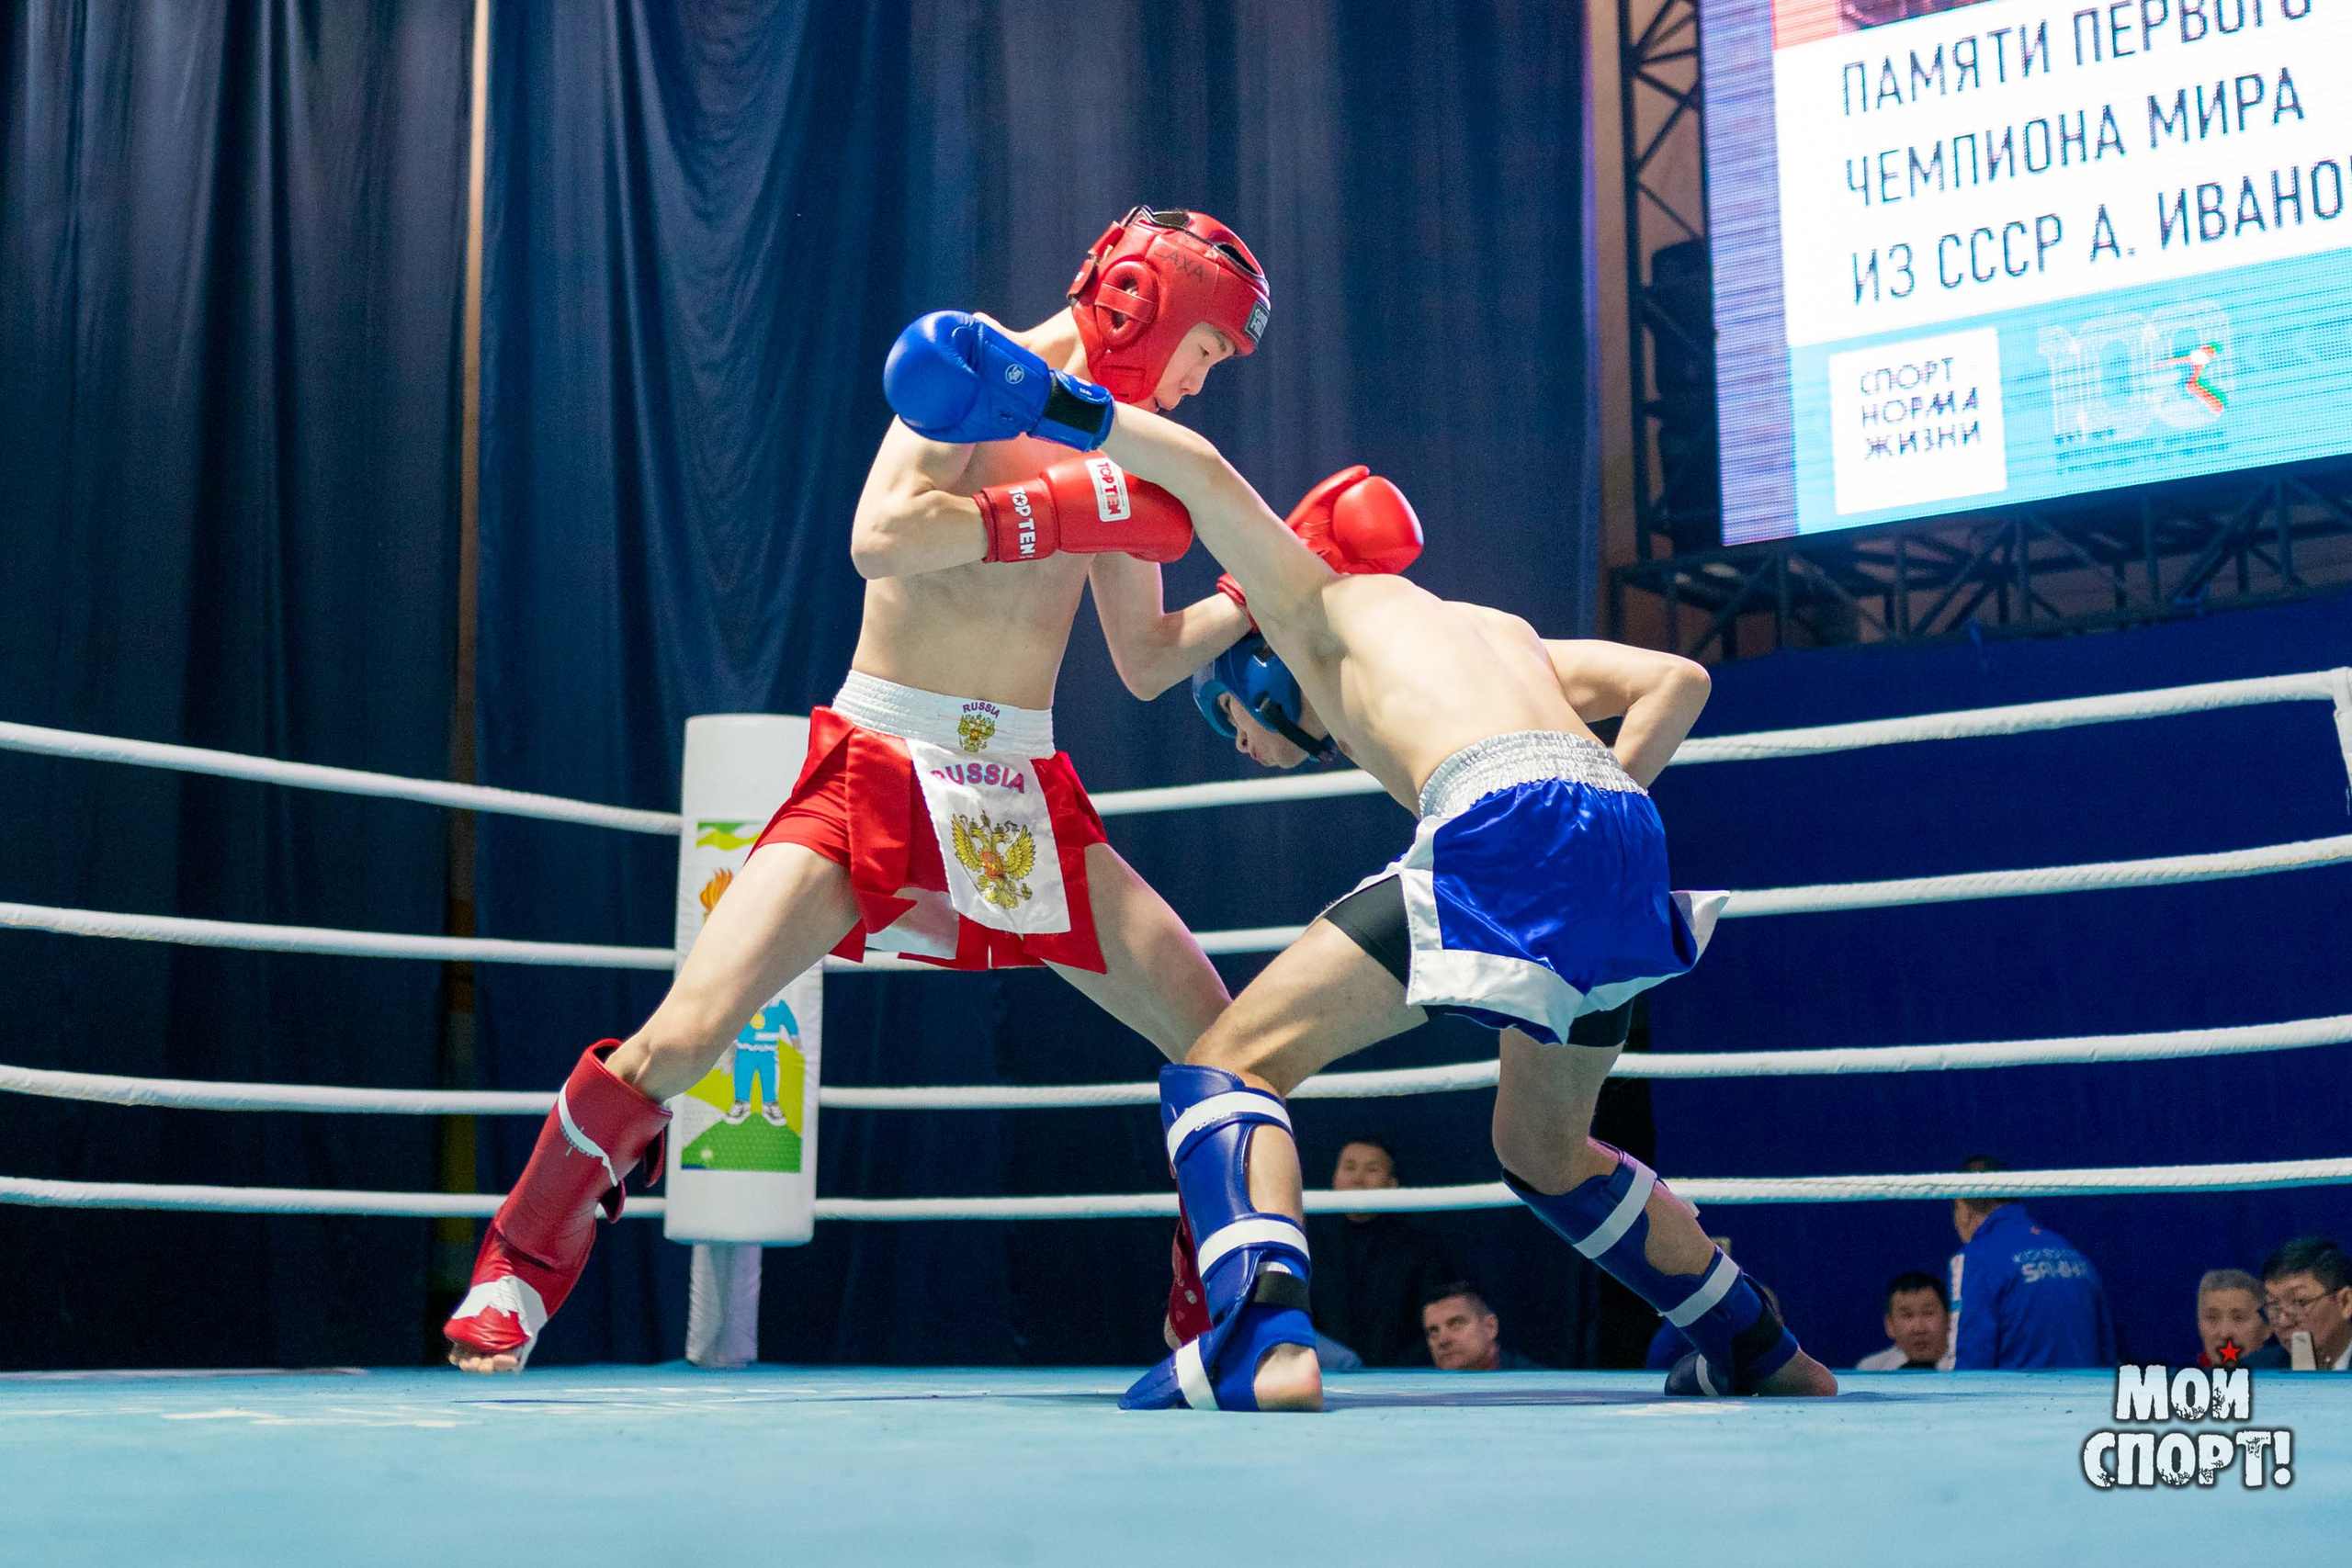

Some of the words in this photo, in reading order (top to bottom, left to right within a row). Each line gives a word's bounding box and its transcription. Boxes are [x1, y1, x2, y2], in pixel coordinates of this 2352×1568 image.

[1843, 19, 2050, 116] ПАМЯТИ
[1847, 104, 2124, 205] ЧЕМПИОНА
[2147, 67, 2304, 149] МИРА
[1852, 243, 1915, 305] ИЗ
[1939, 213, 2063, 288] СССР
[2090, 204, 2135, 262] А.
[2158, 155, 2352, 249] ИВАНО
[1861, 357, 1953, 395] СПОРТ
[1862, 387, 1978, 428] НОРМА
[1864, 419, 1981, 460] ЖИЗНИ
[1097, 462, 1114, 484] TOP
[1009, 486, 1032, 517] TOP
[1018, 517, 1036, 555] TEN
[963, 702, 1000, 718] RUSSIA
